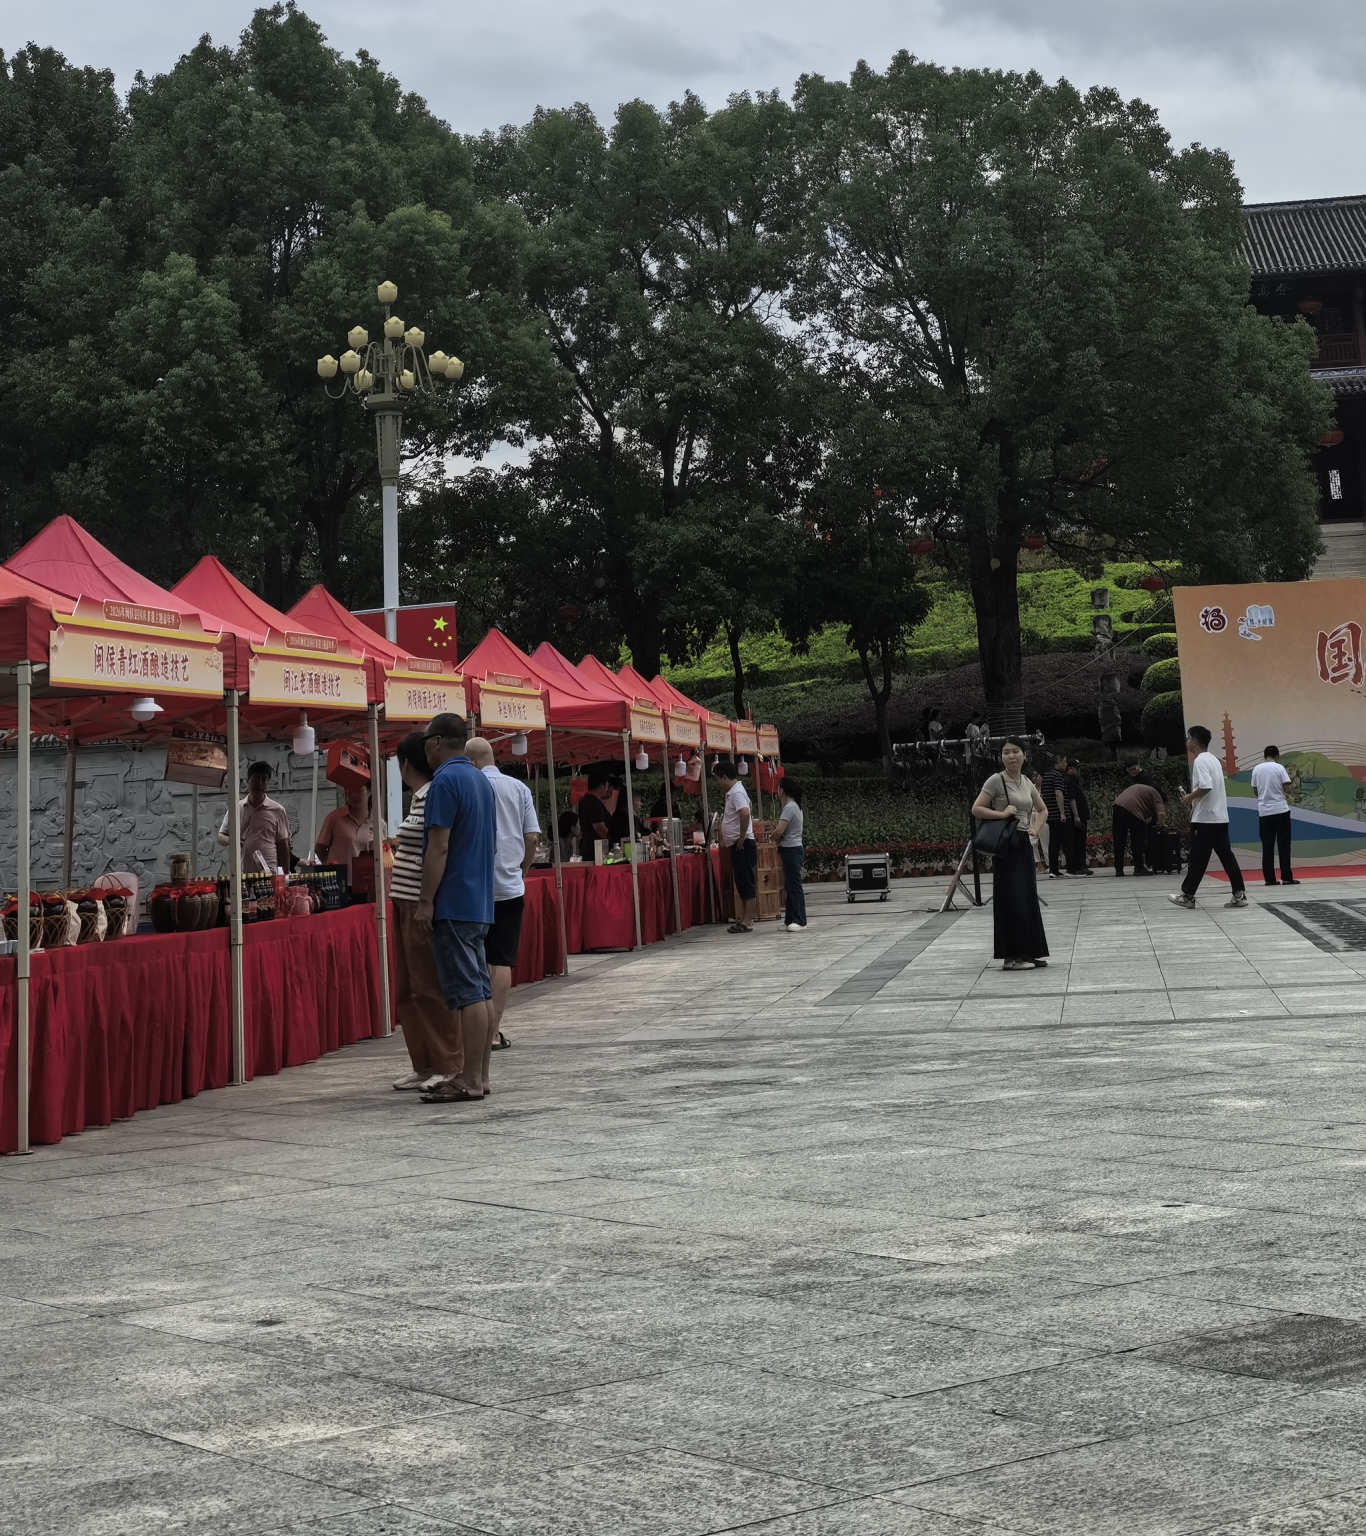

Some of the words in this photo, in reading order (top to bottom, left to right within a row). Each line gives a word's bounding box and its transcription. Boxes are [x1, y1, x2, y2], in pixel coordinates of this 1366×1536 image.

[94, 643, 190, 682] 闽侯青红酒酿造技艺
[283, 667, 341, 698] 闽江老酒酿造技艺
